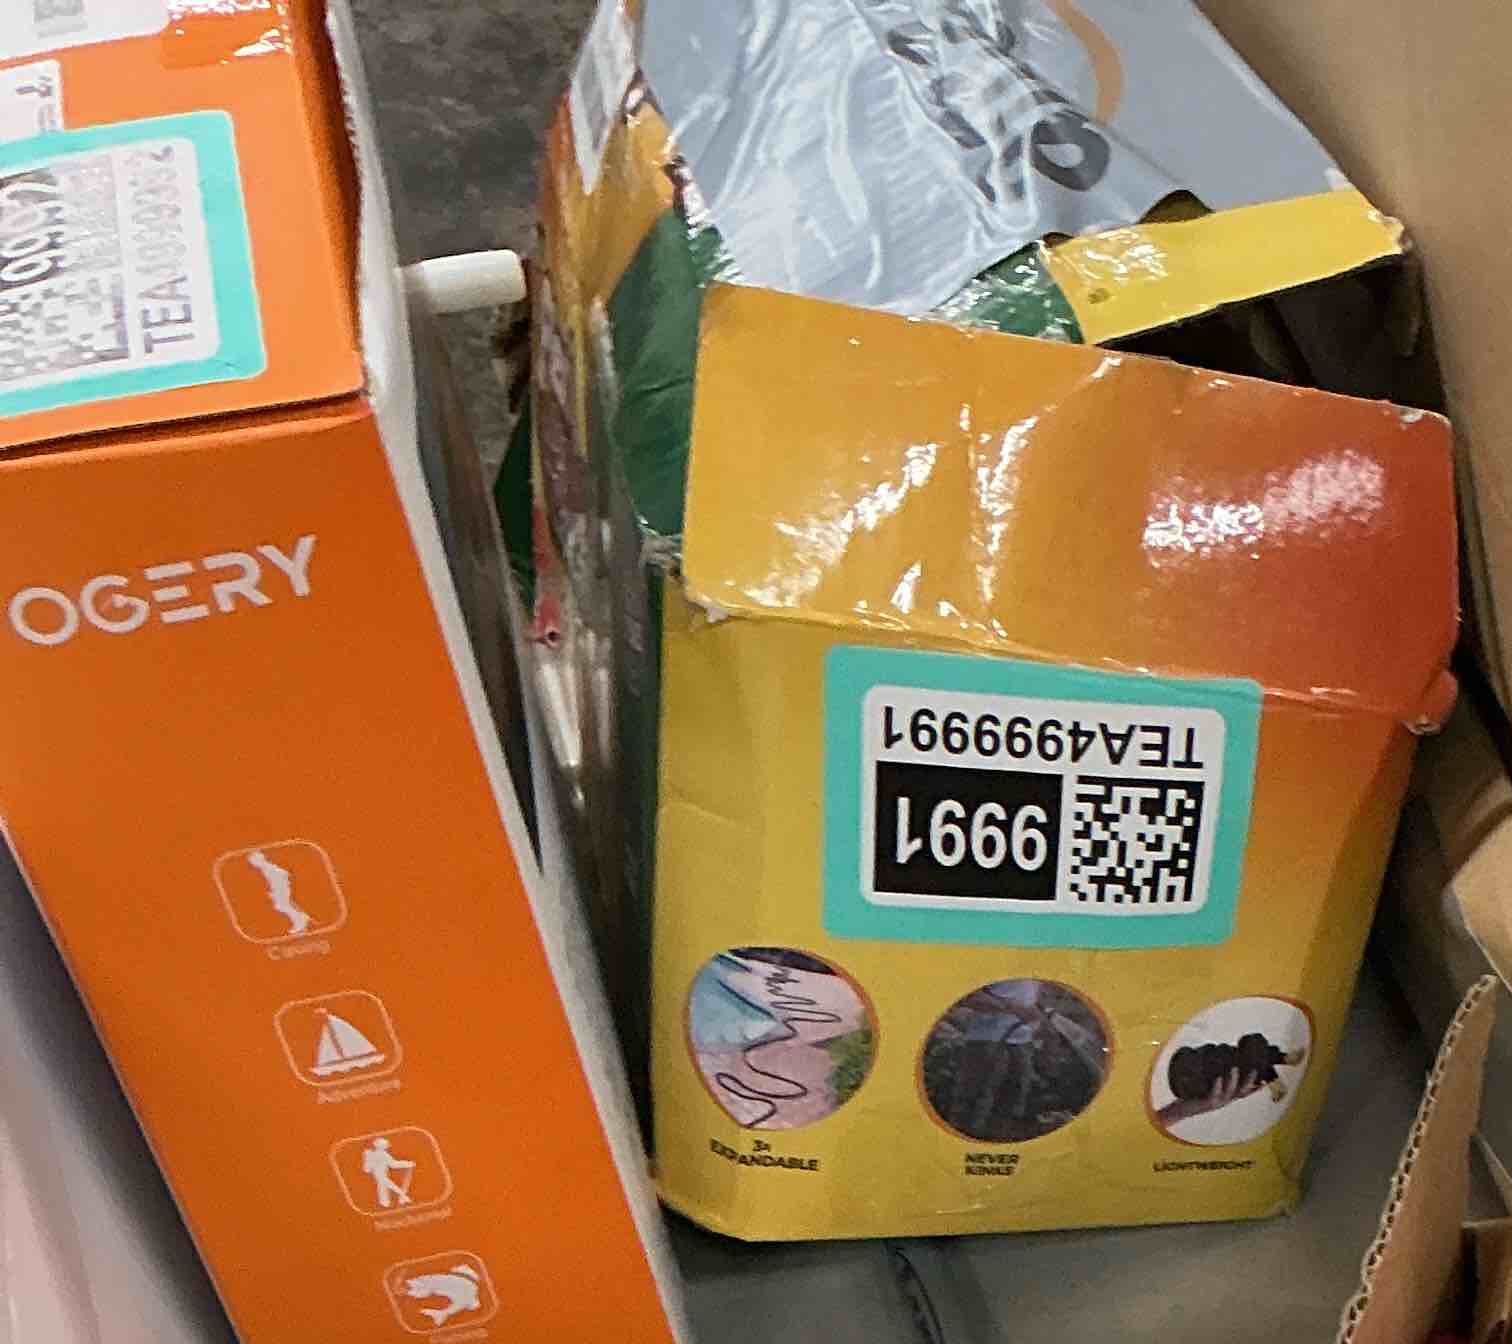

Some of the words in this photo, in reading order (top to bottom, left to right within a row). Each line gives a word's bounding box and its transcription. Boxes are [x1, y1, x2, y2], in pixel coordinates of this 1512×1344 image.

[9, 534, 317, 646] OGERY
[882, 704, 1205, 770] TEA4999991
[895, 796, 1049, 872] 9991
